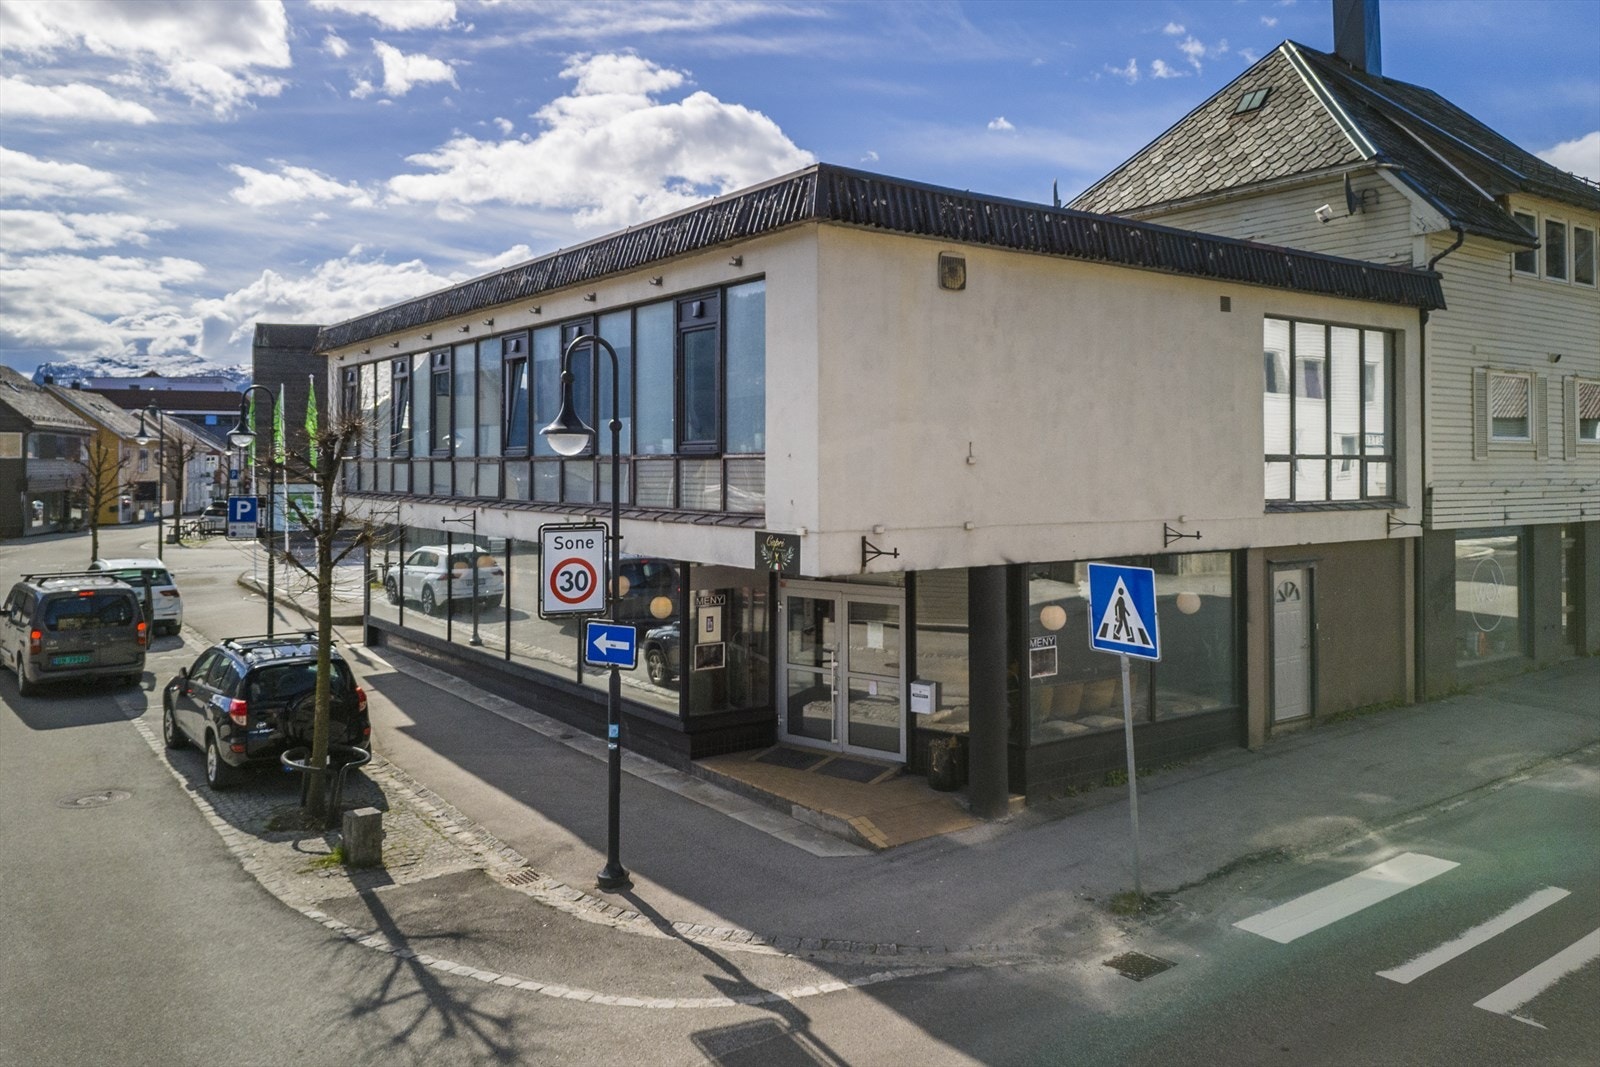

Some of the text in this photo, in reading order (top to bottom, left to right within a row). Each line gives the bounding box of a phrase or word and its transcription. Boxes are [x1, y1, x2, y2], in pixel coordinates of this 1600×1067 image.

[236, 500, 252, 520] P
[554, 536, 595, 550] Sone
[559, 570, 589, 592] 30
[695, 595, 723, 605] MENY
[1029, 637, 1054, 647] MENY
